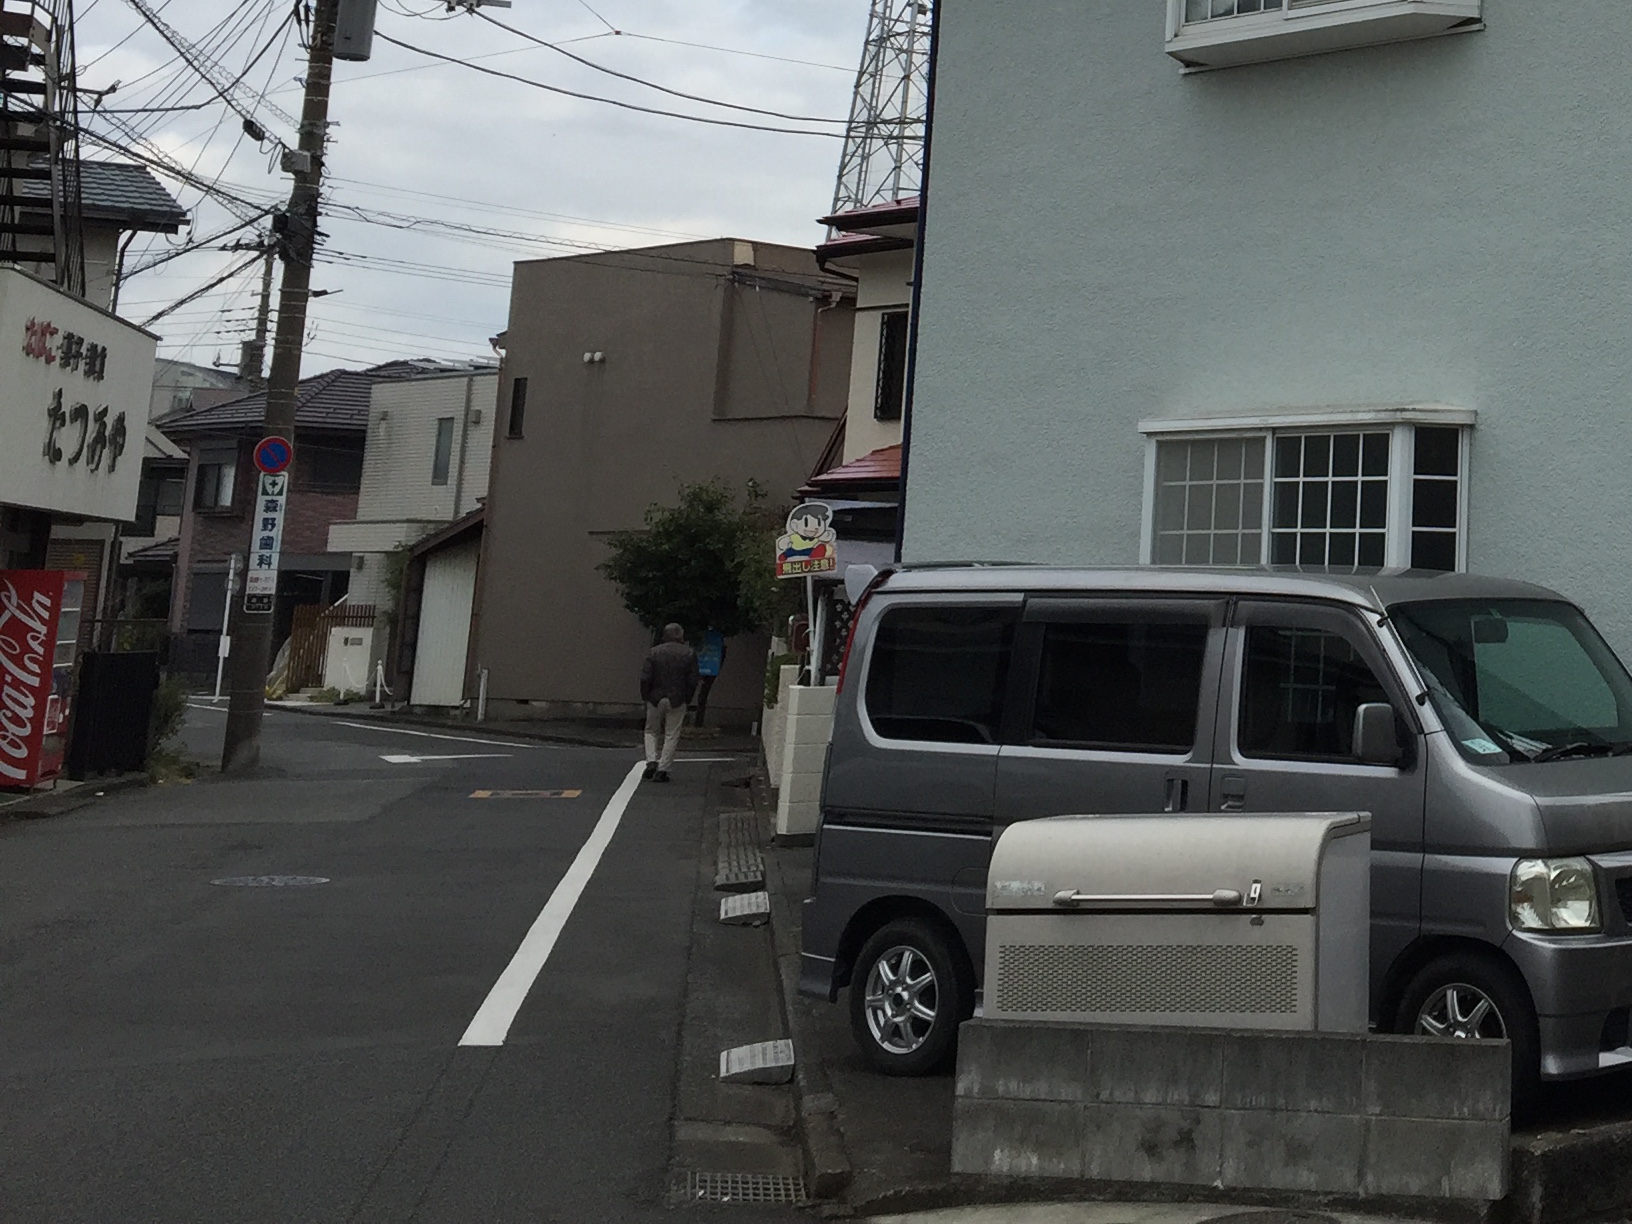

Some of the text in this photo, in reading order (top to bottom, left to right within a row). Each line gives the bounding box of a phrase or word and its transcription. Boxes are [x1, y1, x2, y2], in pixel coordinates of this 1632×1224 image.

[42, 387, 127, 474] たつみや
[256, 498, 280, 570] 森野歯科
